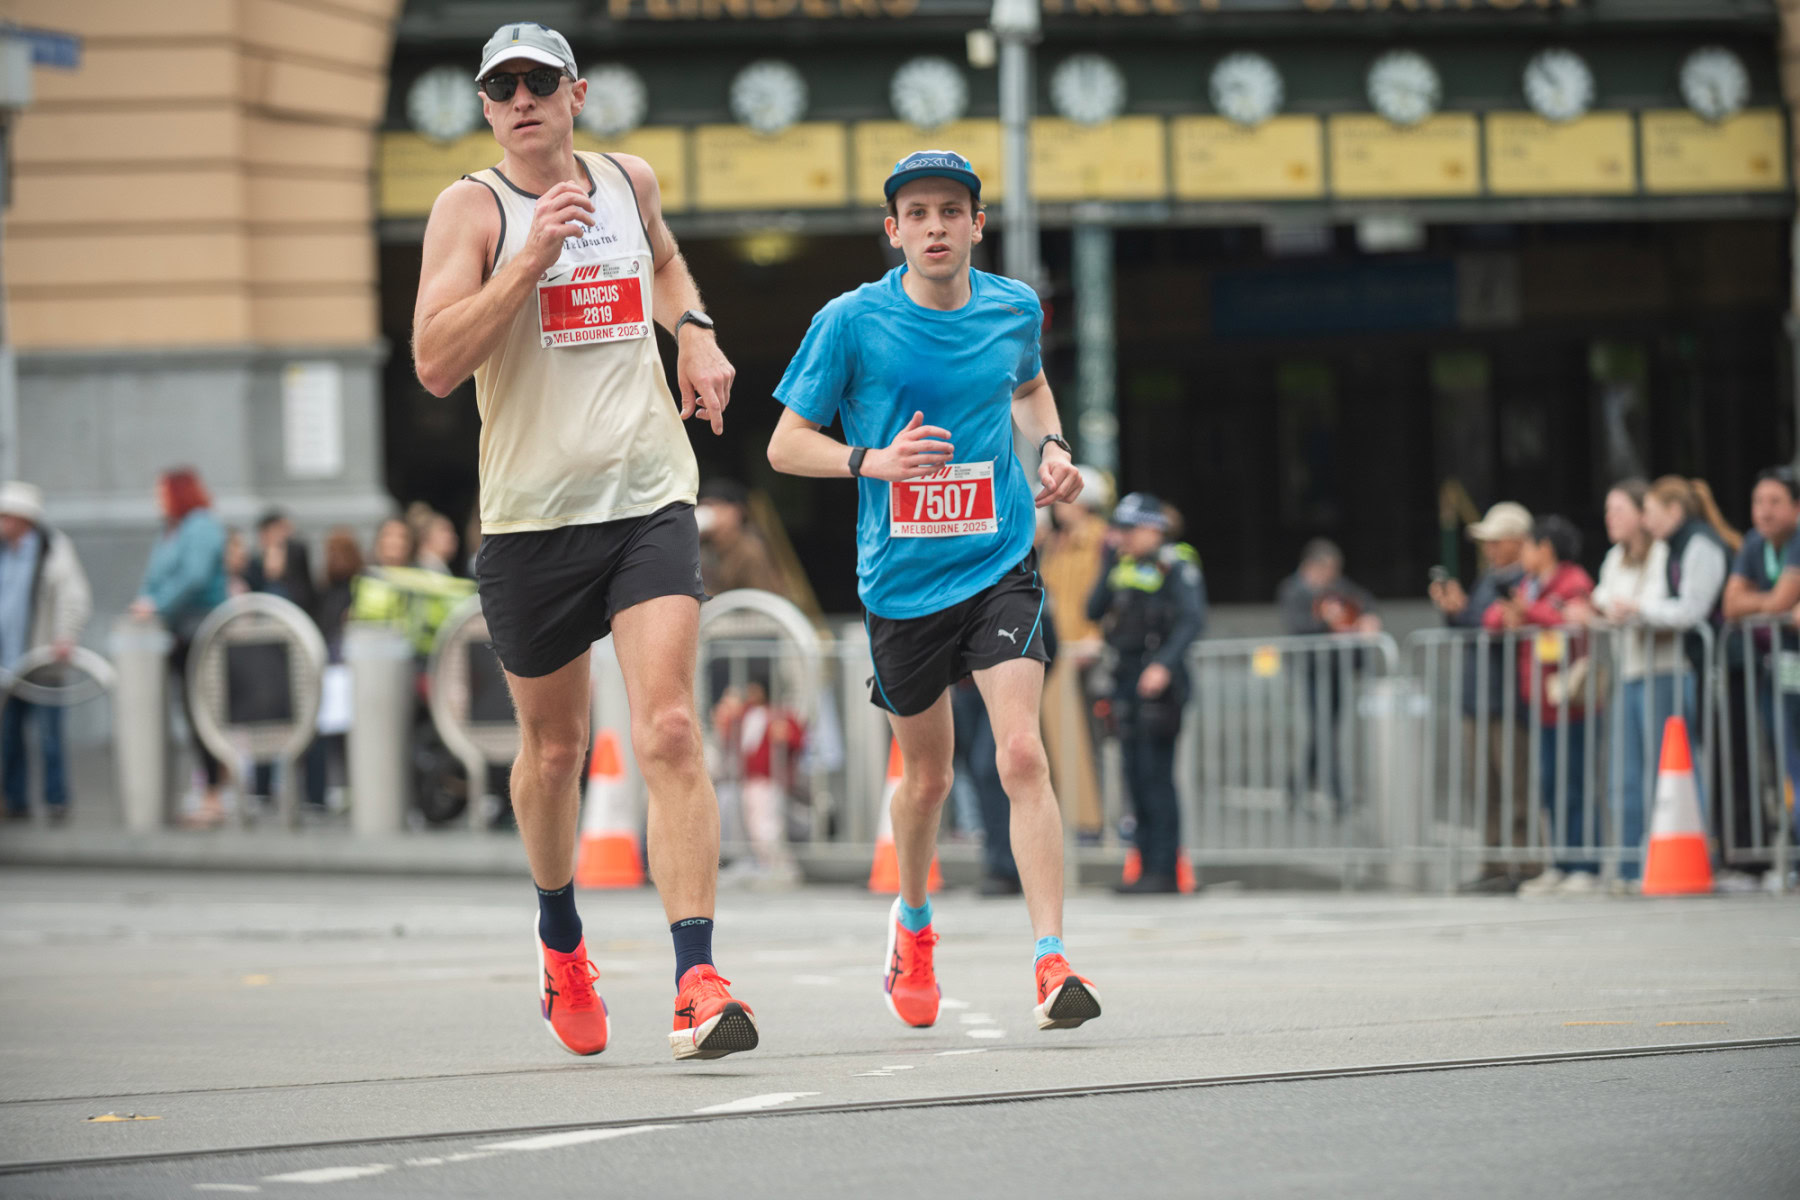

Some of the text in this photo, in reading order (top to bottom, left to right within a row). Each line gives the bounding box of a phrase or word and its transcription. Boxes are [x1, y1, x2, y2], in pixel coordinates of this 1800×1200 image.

[571, 285, 620, 306] MARCUS
[583, 305, 613, 325] 2819
[553, 325, 640, 344] MELBOURNE 2025
[909, 482, 978, 521] 7507
[901, 521, 988, 534] MELBOURNE 2025
